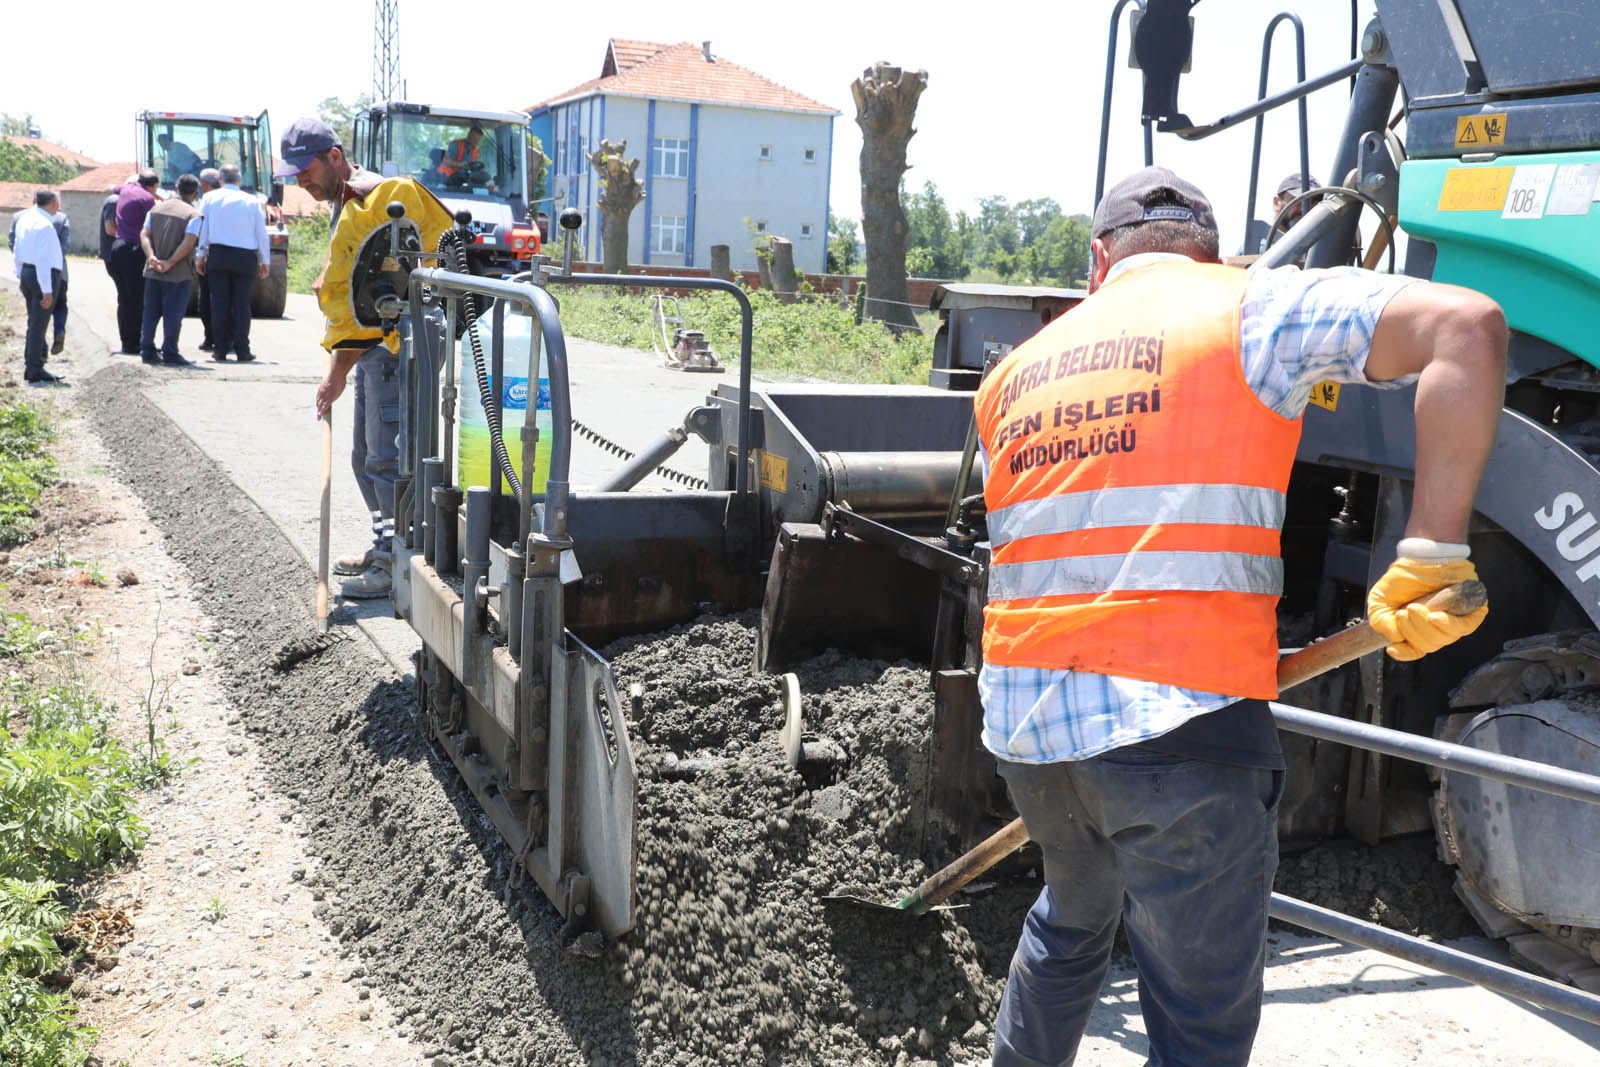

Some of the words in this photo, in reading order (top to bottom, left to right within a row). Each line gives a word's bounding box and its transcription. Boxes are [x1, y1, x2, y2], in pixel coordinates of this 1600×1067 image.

[1510, 188, 1536, 213] 108
[1001, 358, 1052, 418] BAFRA
[1056, 330, 1164, 377] BELEDİYESİ
[998, 411, 1042, 450] FEN
[1053, 383, 1160, 432] İŞLERİ
[1010, 423, 1136, 476] MÜDÜRLÜĞÜ
